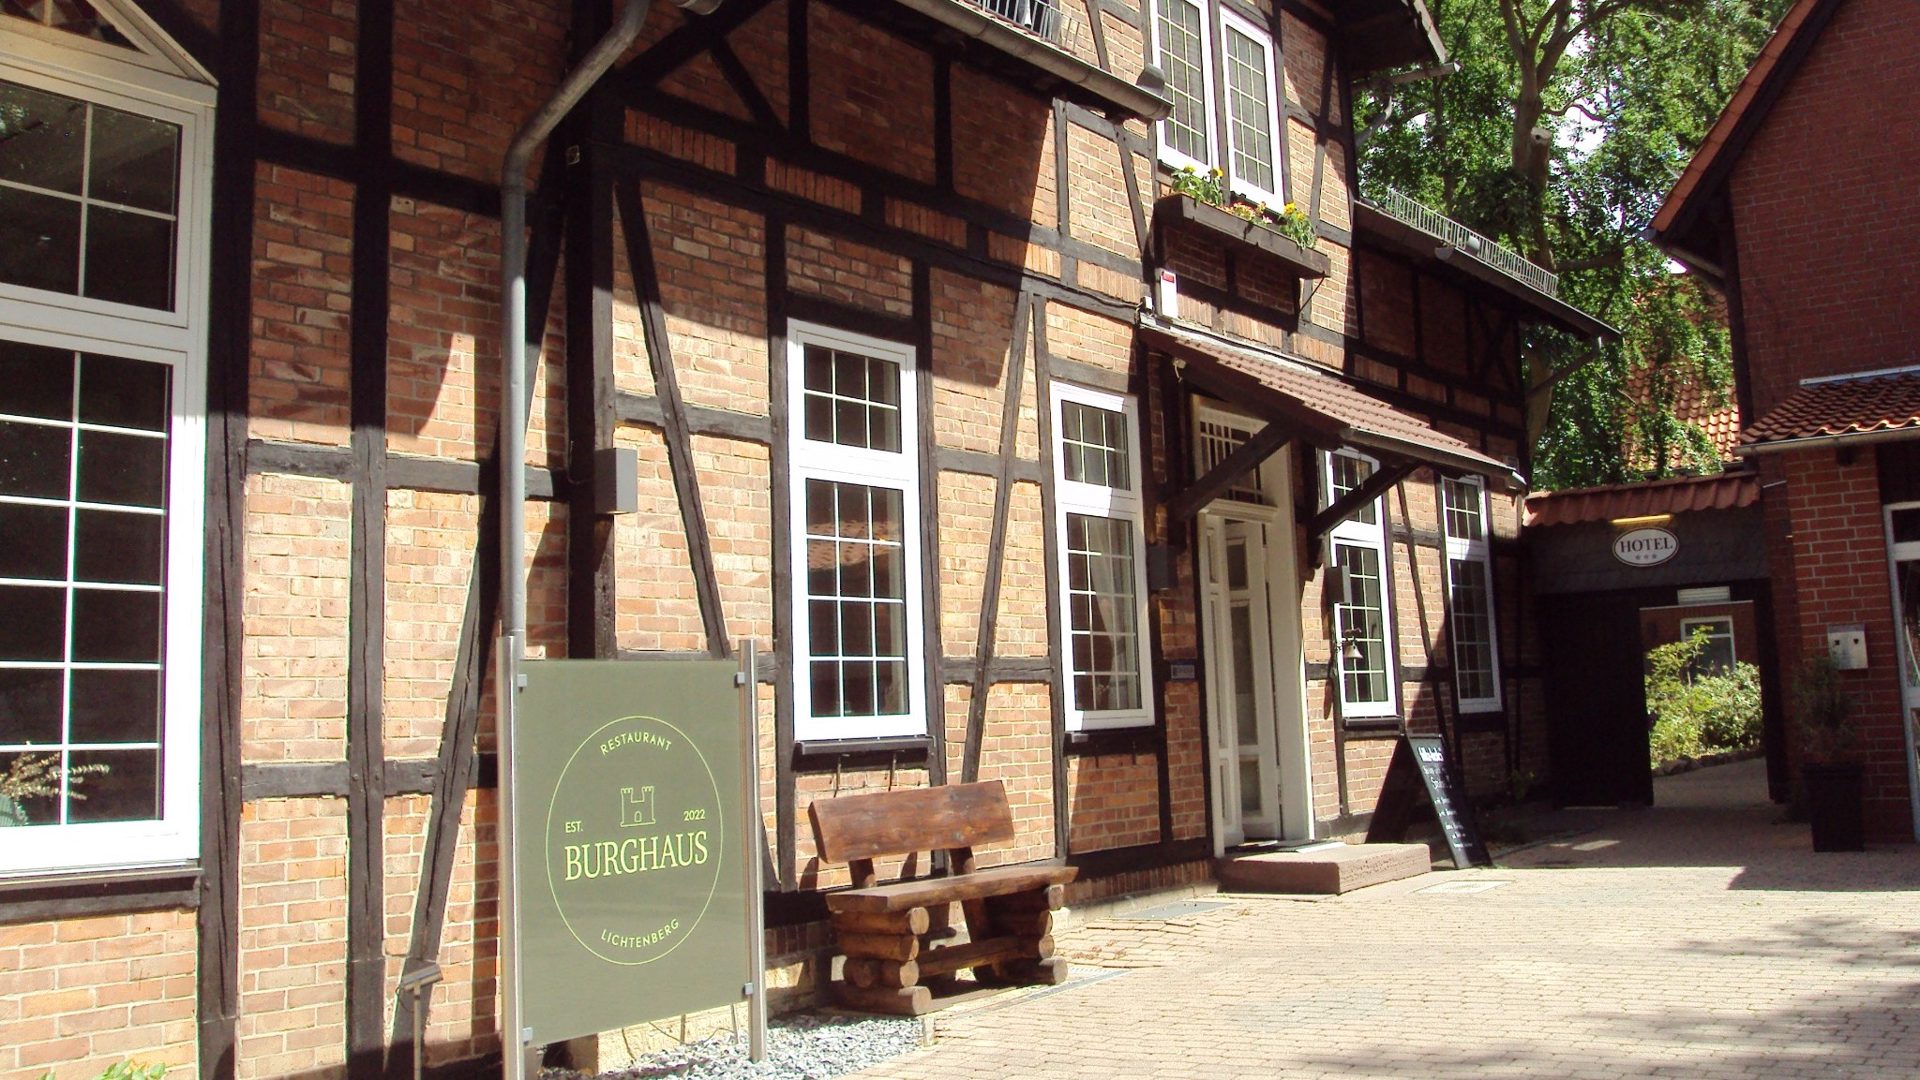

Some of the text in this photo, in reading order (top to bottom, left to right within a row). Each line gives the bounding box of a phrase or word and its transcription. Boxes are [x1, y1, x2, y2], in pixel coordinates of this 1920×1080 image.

[1620, 537, 1673, 553] HOTEL
[600, 731, 672, 756] RESTAURANT
[565, 808, 706, 833] EST. 2022
[565, 831, 708, 881] BURGHAUS
[601, 918, 680, 949] LICHTENBERG
